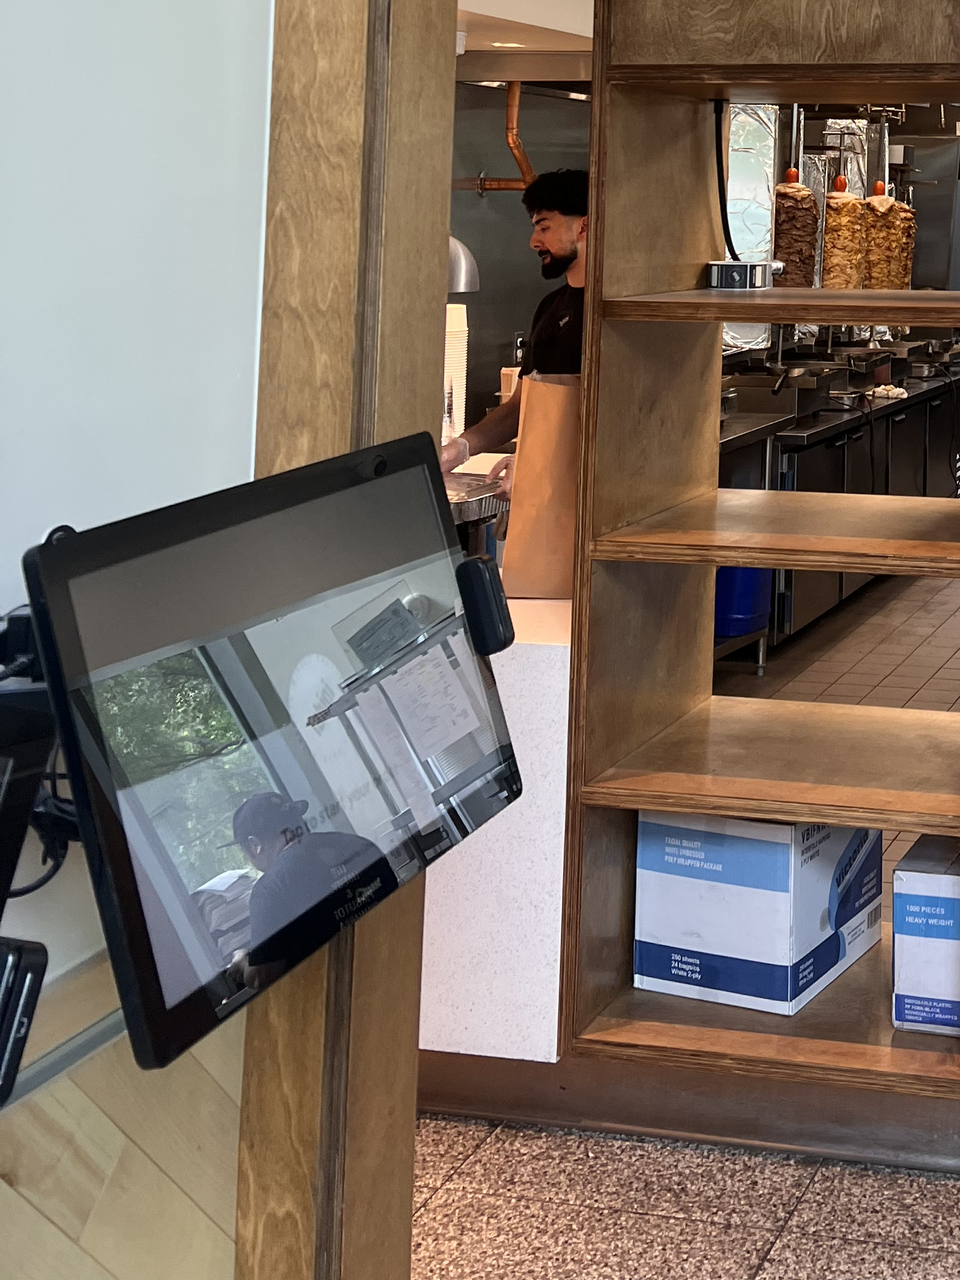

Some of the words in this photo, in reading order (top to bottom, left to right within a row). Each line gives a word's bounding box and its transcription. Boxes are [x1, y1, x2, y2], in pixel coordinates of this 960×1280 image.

[280, 825, 304, 846] Tap
[921, 906, 945, 915] PIECES
[905, 916, 927, 925] HEAVY
[928, 918, 954, 928] WEIGHT
[688, 971, 702, 981] 2-ply
